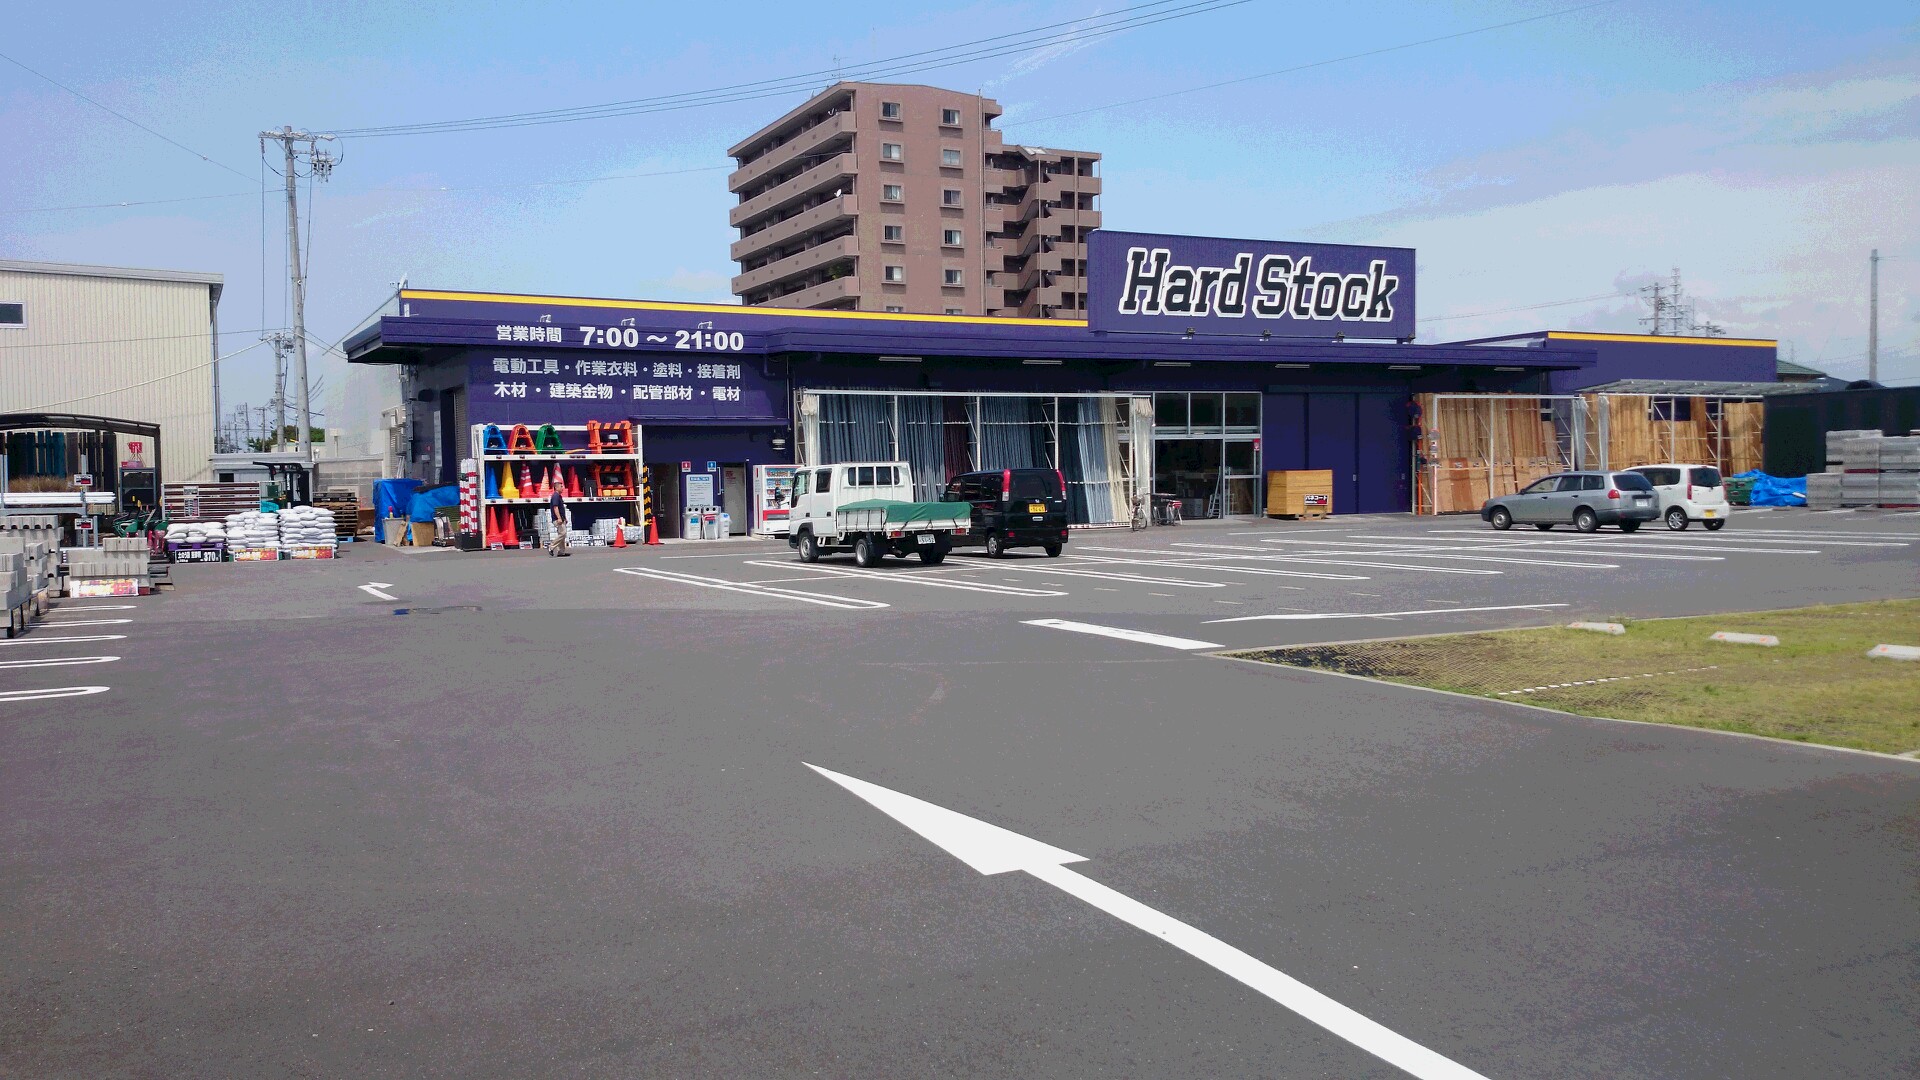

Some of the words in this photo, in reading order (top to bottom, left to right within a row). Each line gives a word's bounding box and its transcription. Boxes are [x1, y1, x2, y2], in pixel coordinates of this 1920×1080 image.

[1119, 247, 1253, 318] Hard
[1252, 254, 1399, 323] Stock
[496, 325, 562, 343] 営業時間
[580, 327, 639, 348] 7:00
[675, 330, 744, 351] 21:00
